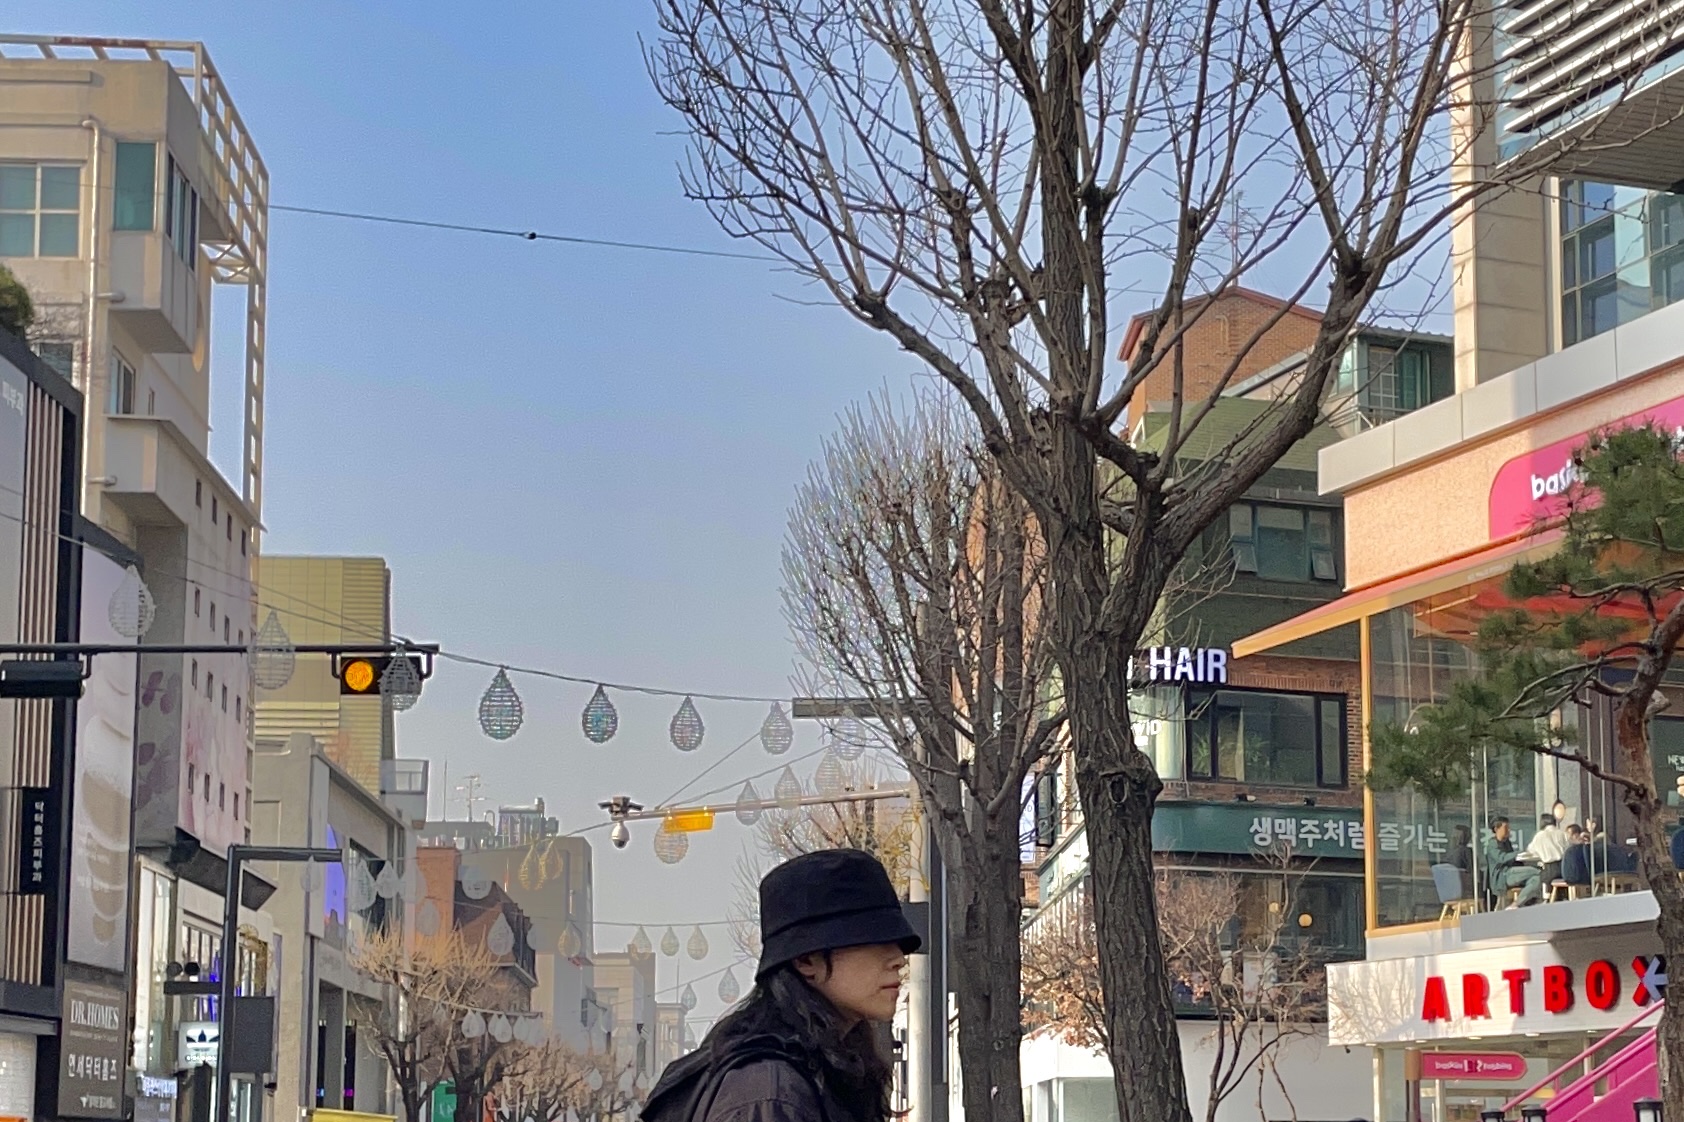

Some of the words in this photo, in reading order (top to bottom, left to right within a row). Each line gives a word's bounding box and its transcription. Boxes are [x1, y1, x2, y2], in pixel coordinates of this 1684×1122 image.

[1149, 646, 1227, 683] HAIR
[1249, 817, 1365, 849] 생맥주처럼
[1378, 822, 1448, 853] 즐기는
[1421, 954, 1668, 1022] ARTBOX
[70, 1000, 119, 1030] DR.HOMES
